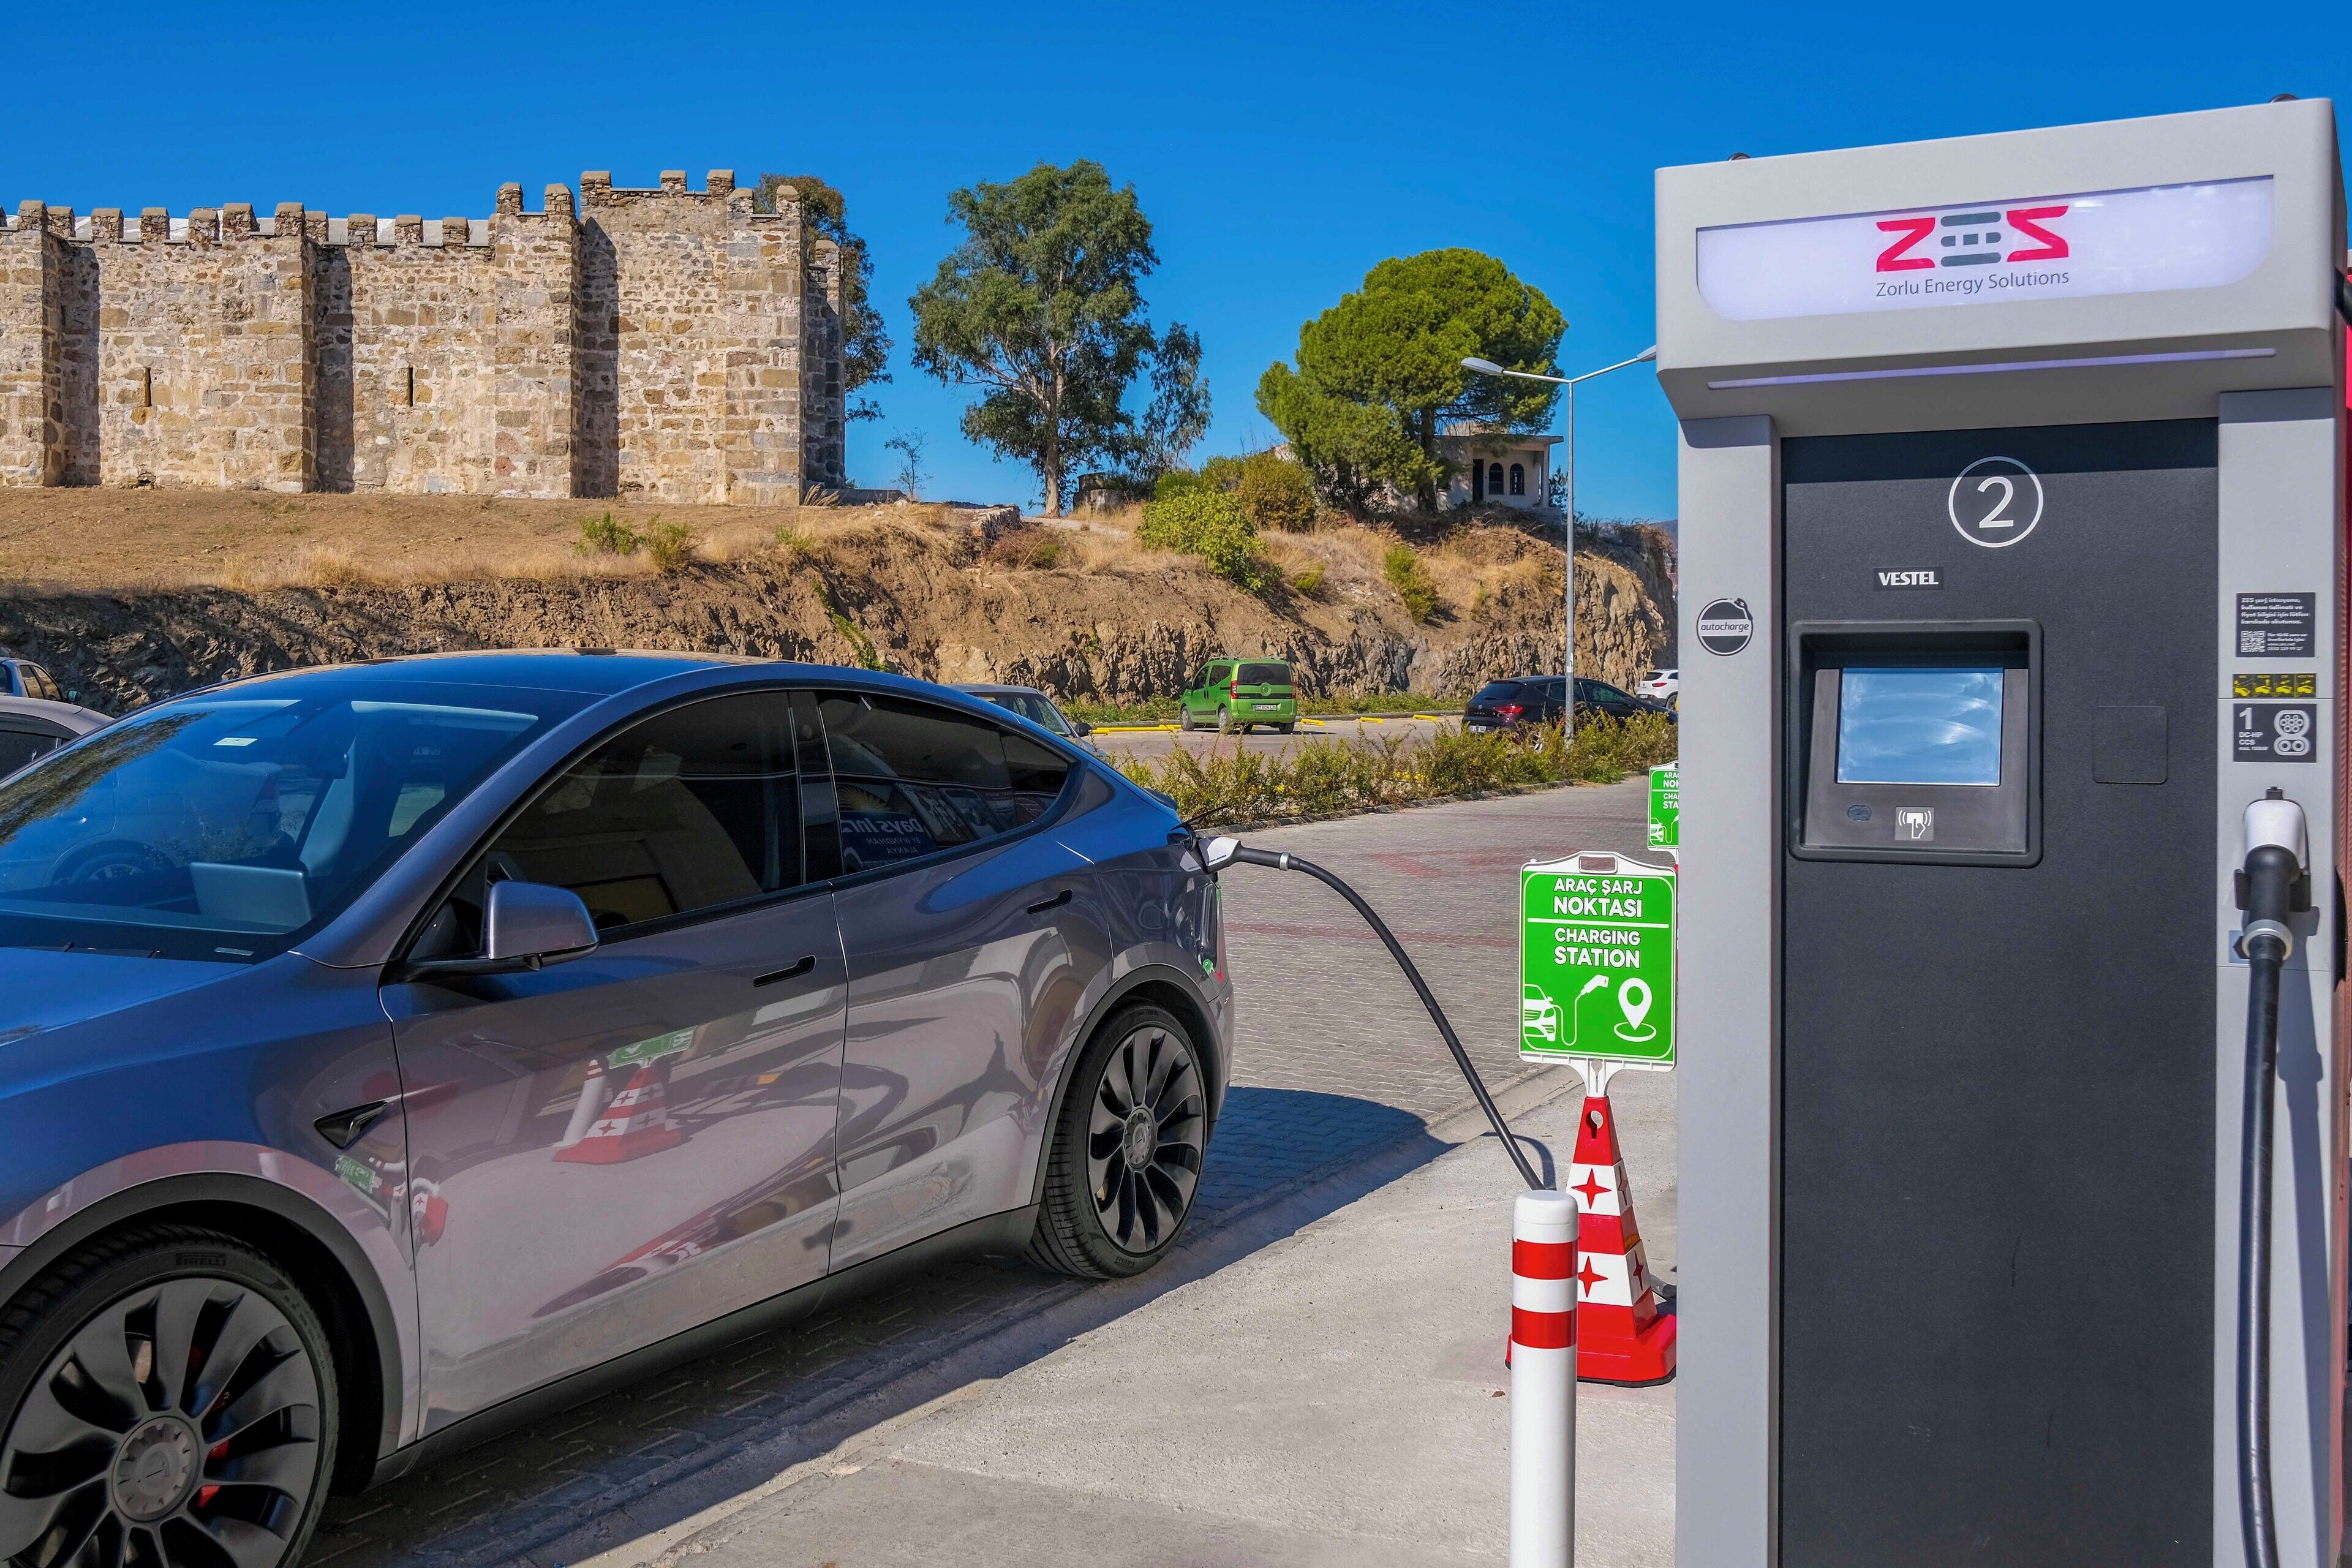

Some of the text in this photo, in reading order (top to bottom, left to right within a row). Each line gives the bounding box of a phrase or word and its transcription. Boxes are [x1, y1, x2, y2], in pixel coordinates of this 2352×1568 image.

[1876, 205, 2068, 272] ZES
[1876, 271, 2069, 296] Zorlu Energy Solutions
[1977, 476, 2013, 528] 2
[1878, 571, 1939, 586] VESTEL
[1701, 622, 1749, 633] autocharge
[2239, 707, 2253, 729] 1
[1553, 877, 1643, 897] ARAÇ ŞARJ
[1553, 895, 1643, 918] NOKTASI
[1555, 927, 1642, 946] CHARGING
[1554, 945, 1641, 969] STATION
[175, 1252, 227, 1266] PIRELLI
